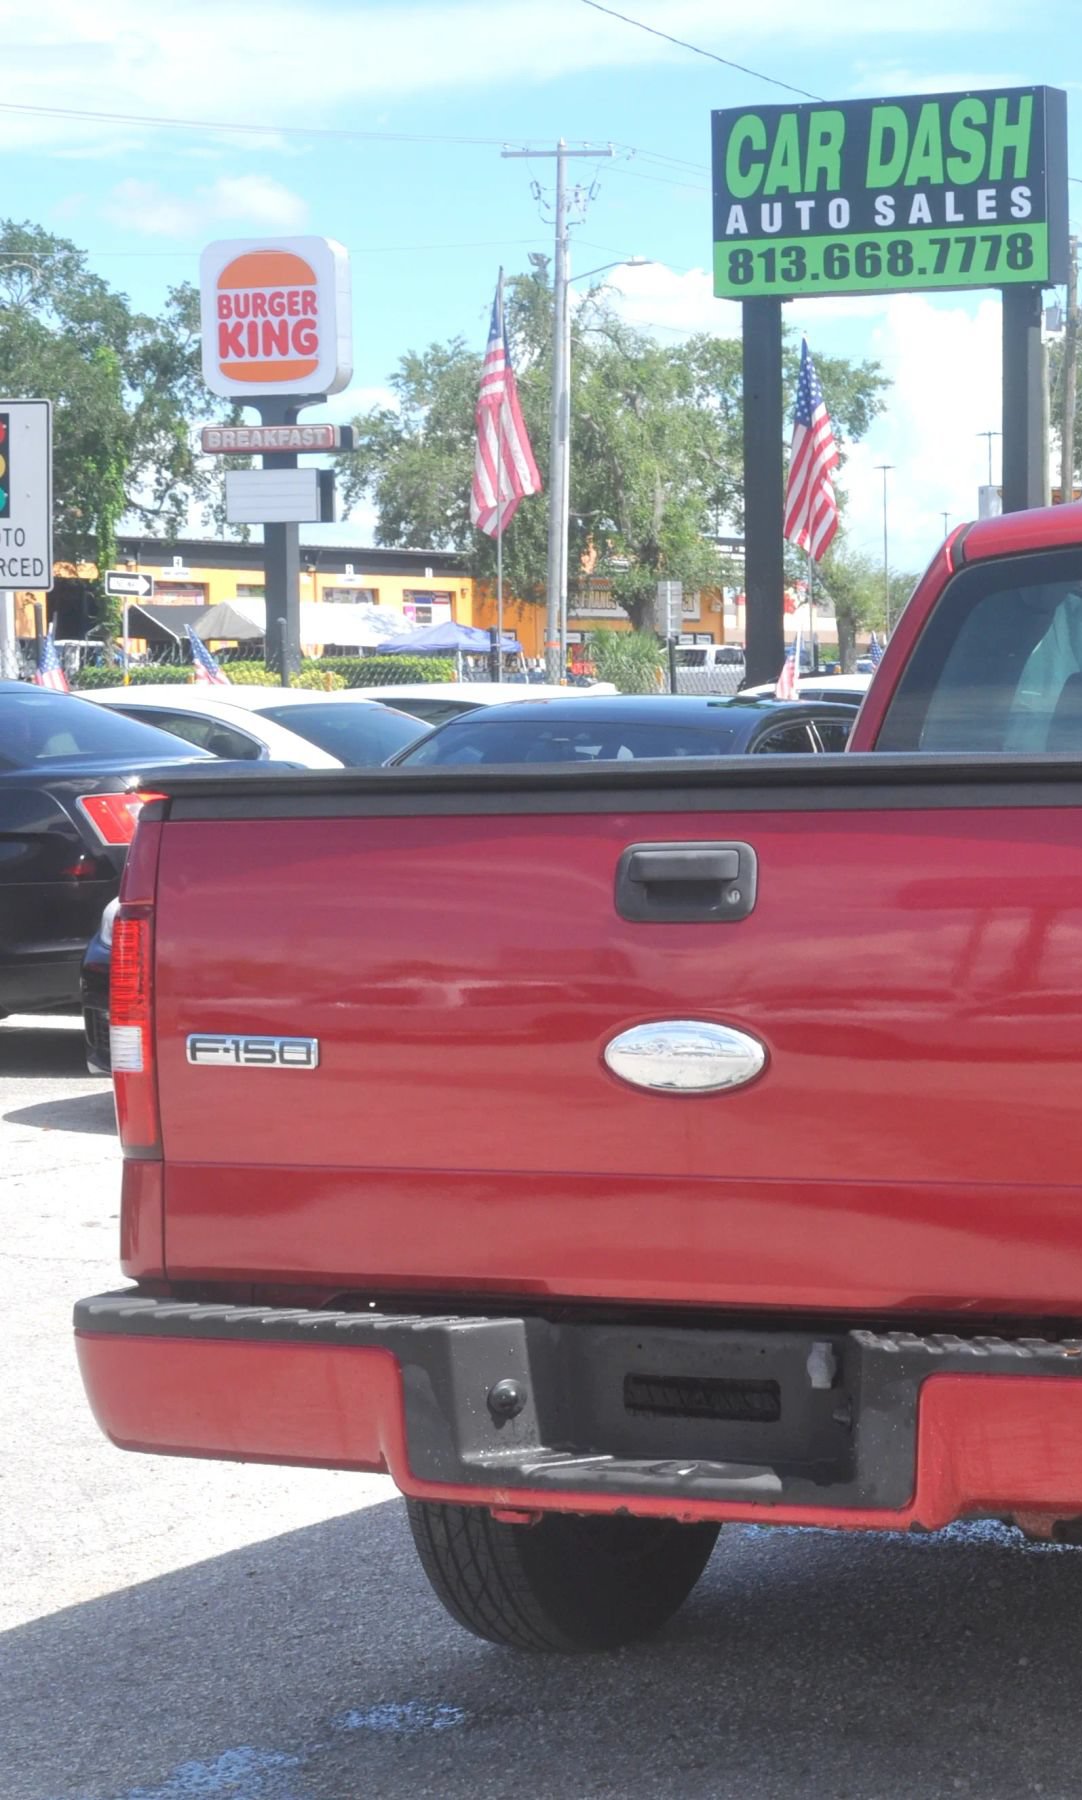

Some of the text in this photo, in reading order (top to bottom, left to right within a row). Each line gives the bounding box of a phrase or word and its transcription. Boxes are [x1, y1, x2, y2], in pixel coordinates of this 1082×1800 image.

[725, 95, 1034, 199] CAR DASH
[725, 186, 1033, 235] AUTO SALES
[727, 232, 1034, 286] 813.668.7778
[217, 290, 318, 320] BURGER
[218, 318, 319, 359] KING
[208, 428, 326, 448] BREAKFAST
[0, 527, 26, 547] TO
[189, 1037, 312, 1066] F-150
